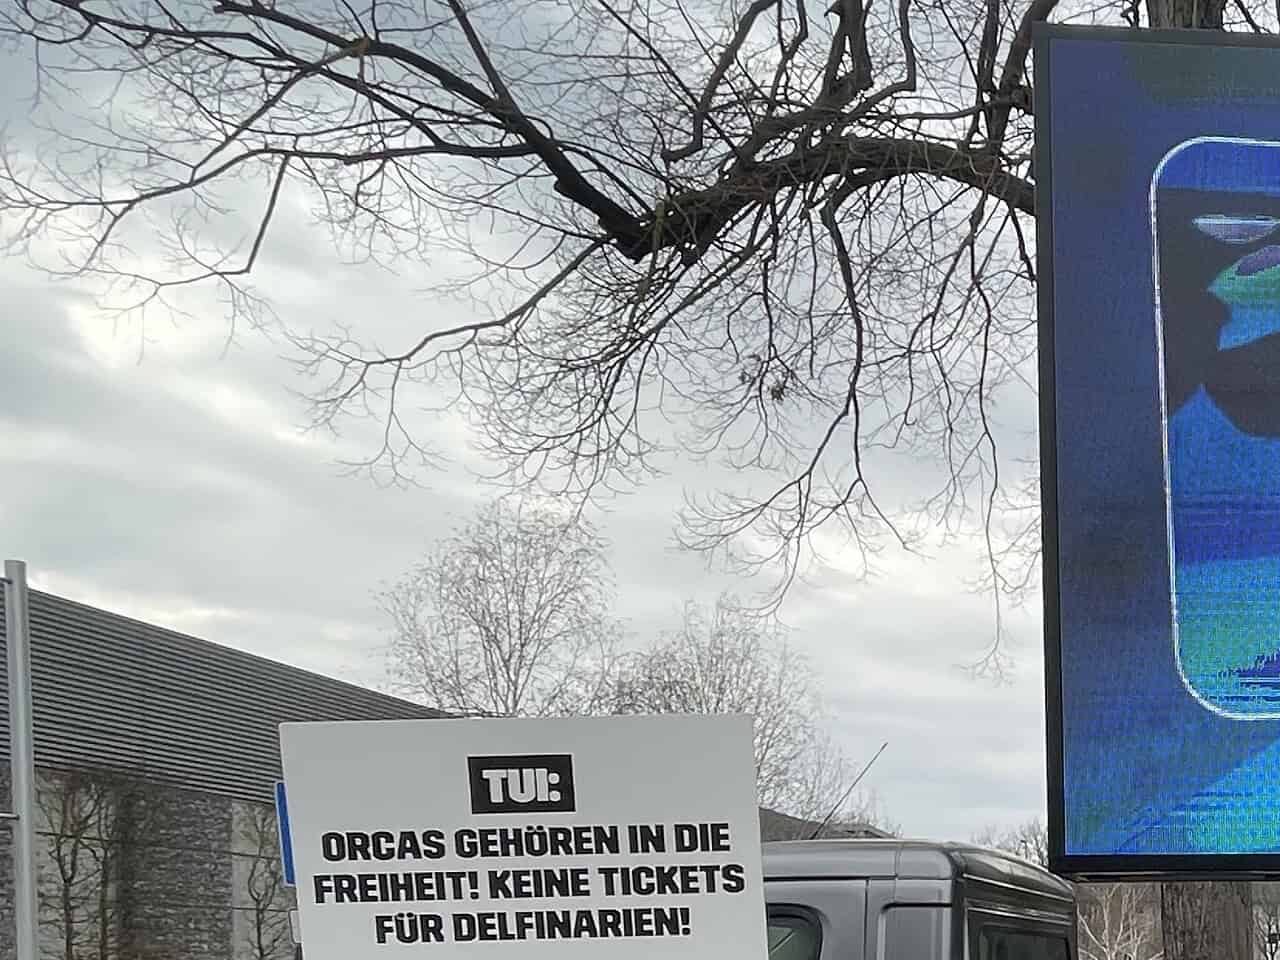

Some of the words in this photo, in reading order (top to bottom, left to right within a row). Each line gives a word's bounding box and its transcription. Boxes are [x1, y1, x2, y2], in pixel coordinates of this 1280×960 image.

[321, 829, 446, 862] ORCAS
[454, 825, 620, 859] GEHÖREN
[627, 823, 666, 854] IN
[673, 822, 731, 853] DIE
[312, 870, 480, 904] FREIHEIT!
[487, 867, 591, 900] KEINE
[597, 863, 745, 897] TICKETS
[375, 911, 445, 945] FÜR
[451, 907, 691, 942] DELFINARIEN!
